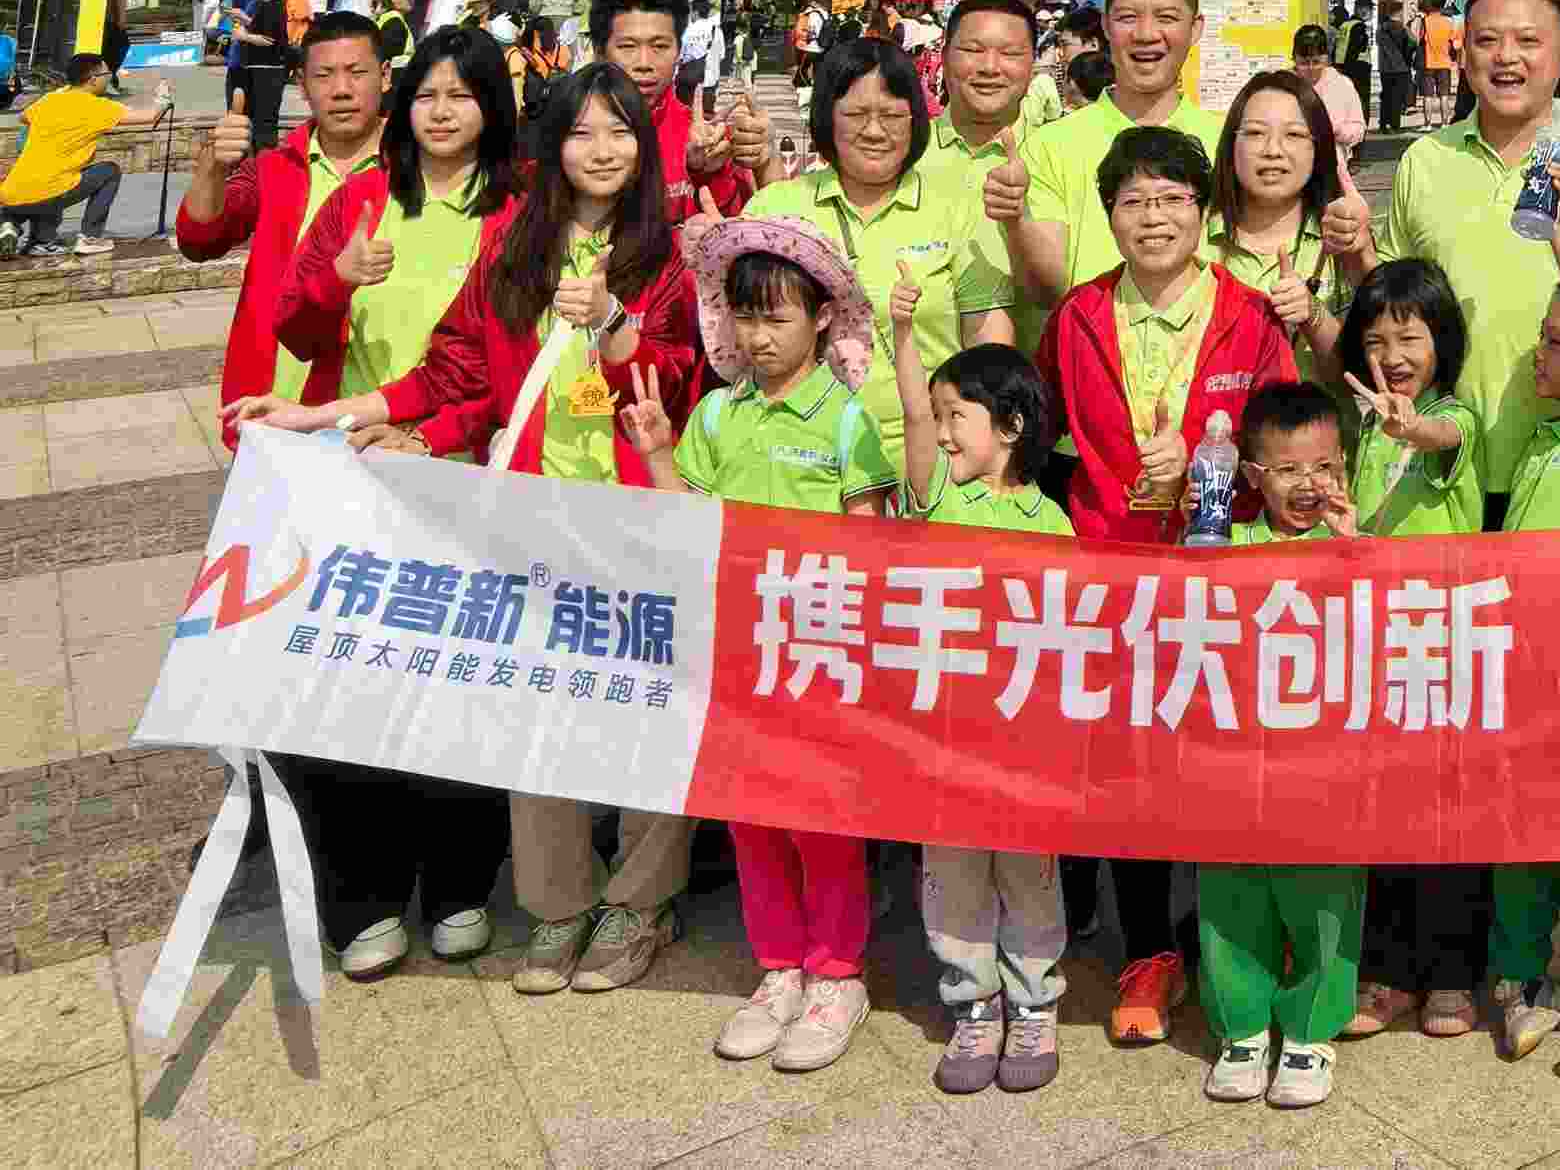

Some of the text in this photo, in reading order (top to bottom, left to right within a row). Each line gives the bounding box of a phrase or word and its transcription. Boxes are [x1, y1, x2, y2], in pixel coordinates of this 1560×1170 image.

[283, 624, 674, 711] 屋顶太阳能发电领跑者
[752, 548, 1514, 731] 携手光伏创新
